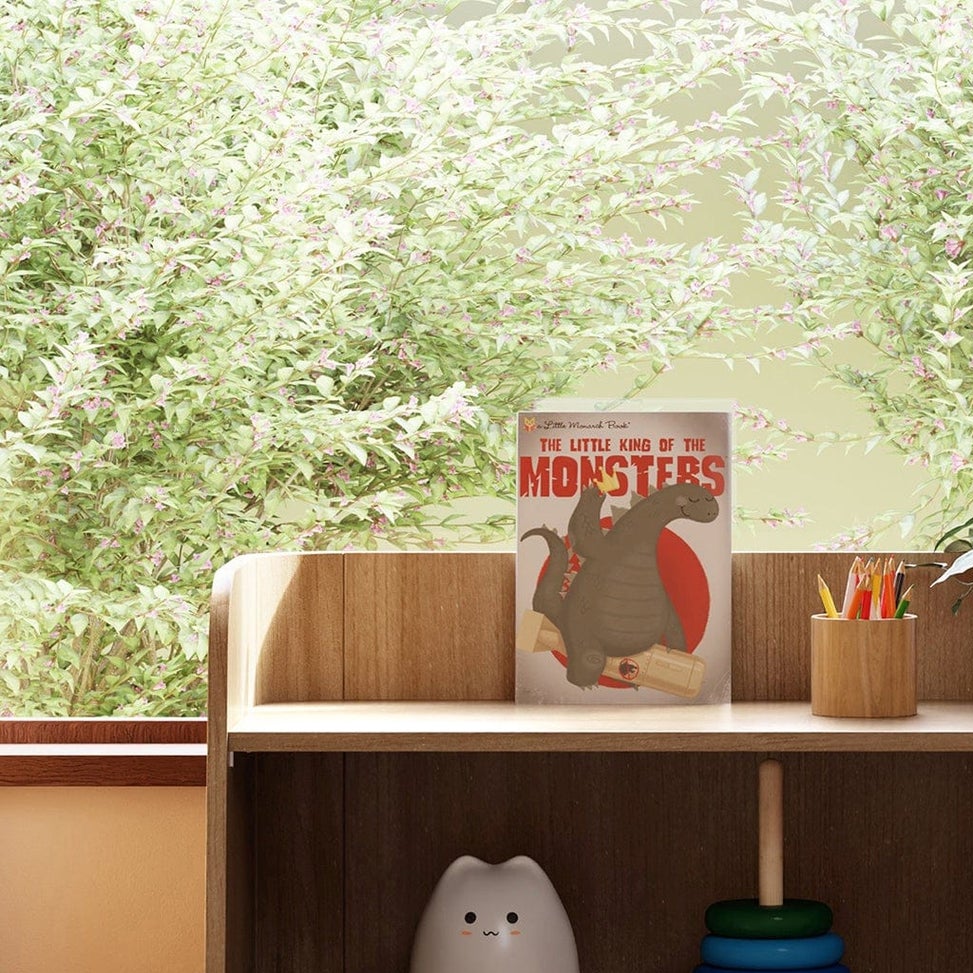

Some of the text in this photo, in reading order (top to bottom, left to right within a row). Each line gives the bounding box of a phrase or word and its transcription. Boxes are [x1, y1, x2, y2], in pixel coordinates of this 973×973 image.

[569, 420, 603, 429] Monarch
[540, 438, 706, 452] THE LITTLE KING OF THE
[519, 454, 726, 498] MONSTERS
